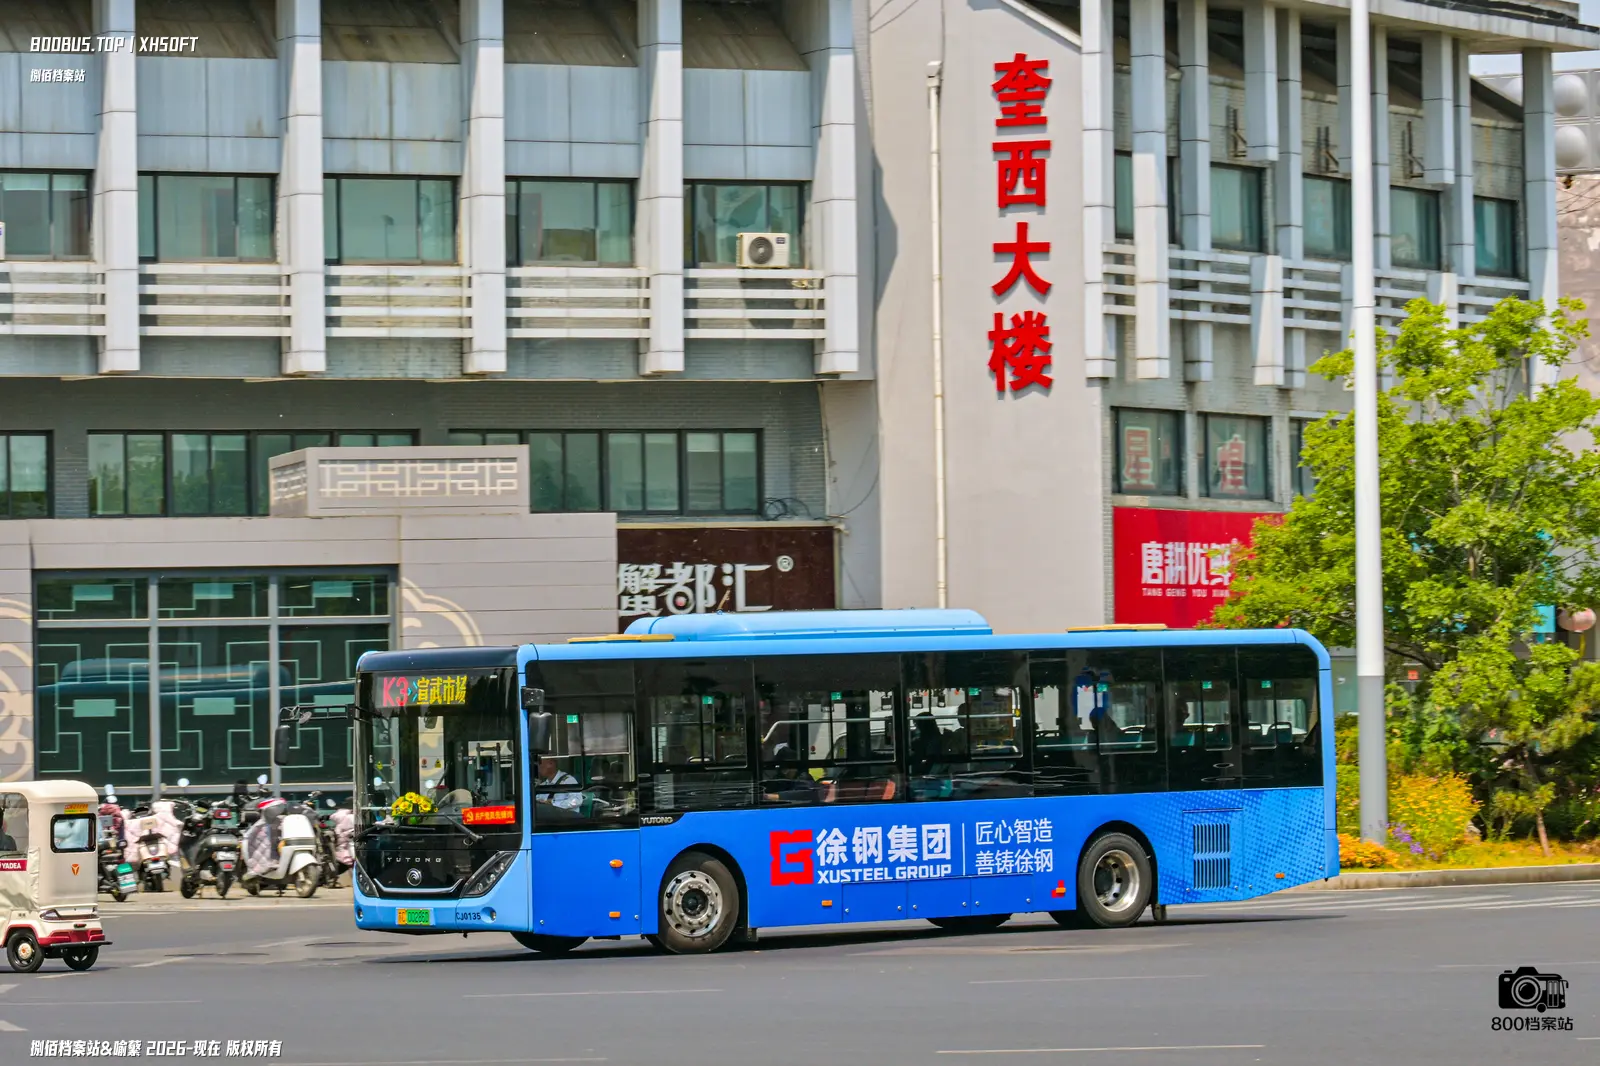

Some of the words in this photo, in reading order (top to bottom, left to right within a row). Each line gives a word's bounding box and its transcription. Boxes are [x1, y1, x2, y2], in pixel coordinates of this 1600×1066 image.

[987, 53, 1053, 392] 奎西大楼
[617, 562, 773, 617] 蟹都汇
[383, 676, 408, 707] K3
[417, 675, 468, 705] 宣武市场
[640, 816, 674, 825] YUTONG
[975, 817, 1053, 845] 匠心智造
[816, 823, 952, 867] 徐钢集团
[817, 867, 893, 884] XUSTEEL
[896, 864, 952, 880] GROUP
[975, 847, 1053, 876] 善铸徐钢
[456, 911, 482, 921] CJ0135
